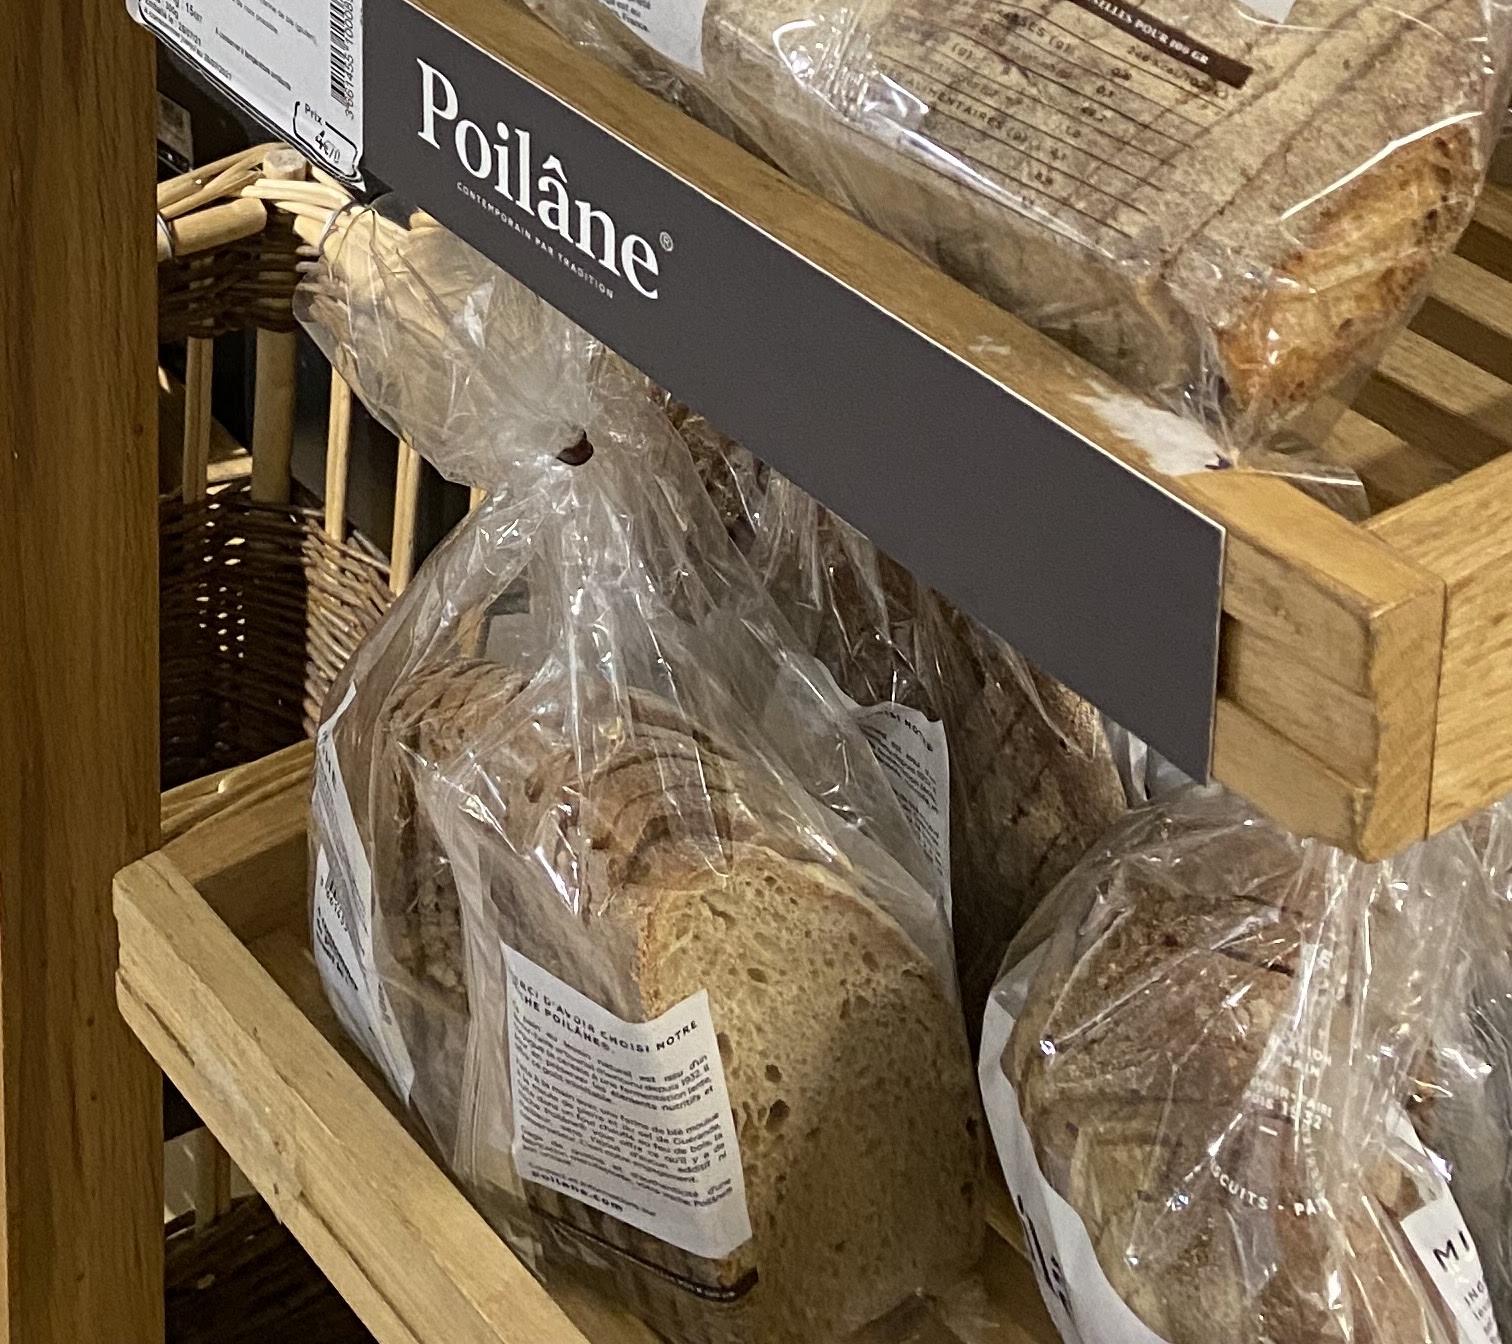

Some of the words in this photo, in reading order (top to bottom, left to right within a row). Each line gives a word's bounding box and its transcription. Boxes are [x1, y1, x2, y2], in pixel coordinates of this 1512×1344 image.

[1135, 18, 1169, 45] POUR
[1190, 46, 1210, 65] GR
[303, 102, 324, 127] Prix
[456, 181, 532, 240] CONTEMPORAIN
[534, 236, 558, 257] PAR
[557, 251, 615, 300] TRADITION
[597, 1030, 649, 1053] CHOISI
[655, 1020, 697, 1050] NOTRE
